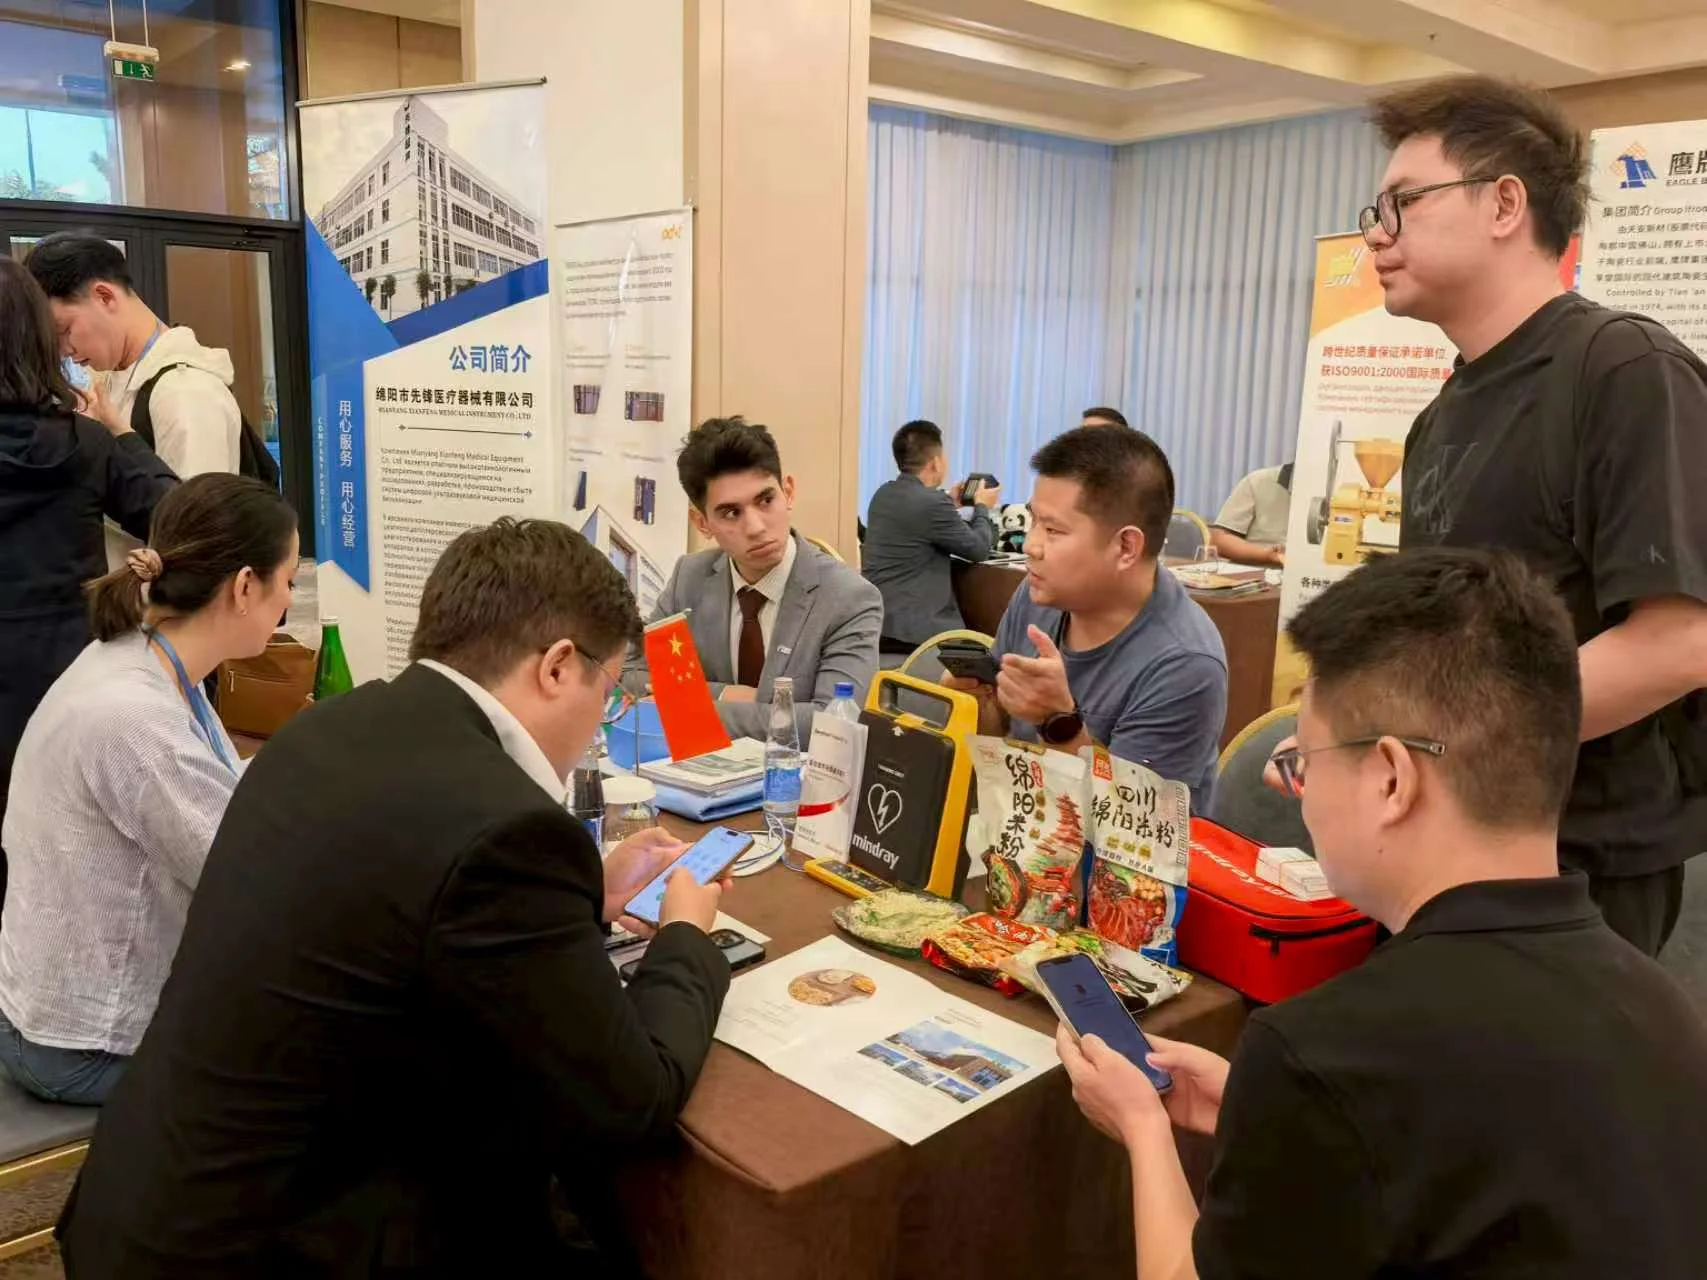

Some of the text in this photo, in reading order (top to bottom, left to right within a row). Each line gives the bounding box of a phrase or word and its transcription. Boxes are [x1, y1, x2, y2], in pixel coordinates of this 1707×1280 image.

[1665, 178, 1698, 187] EAGLE
[1602, 205, 1652, 218] 集团简介
[1653, 207, 1684, 216] Group
[1606, 288, 1652, 297] Controlled
[448, 344, 532, 373] 公司简介
[375, 386, 534, 409] 绵阳市先锋医疗器械有限公司
[339, 400, 355, 548] 用心服务 用心经营
[996, 753, 1035, 859] 绵阳米粉
[1115, 785, 1156, 815] 四川
[1090, 793, 1175, 849] 绵阳米粉
[852, 833, 900, 870] mindray
